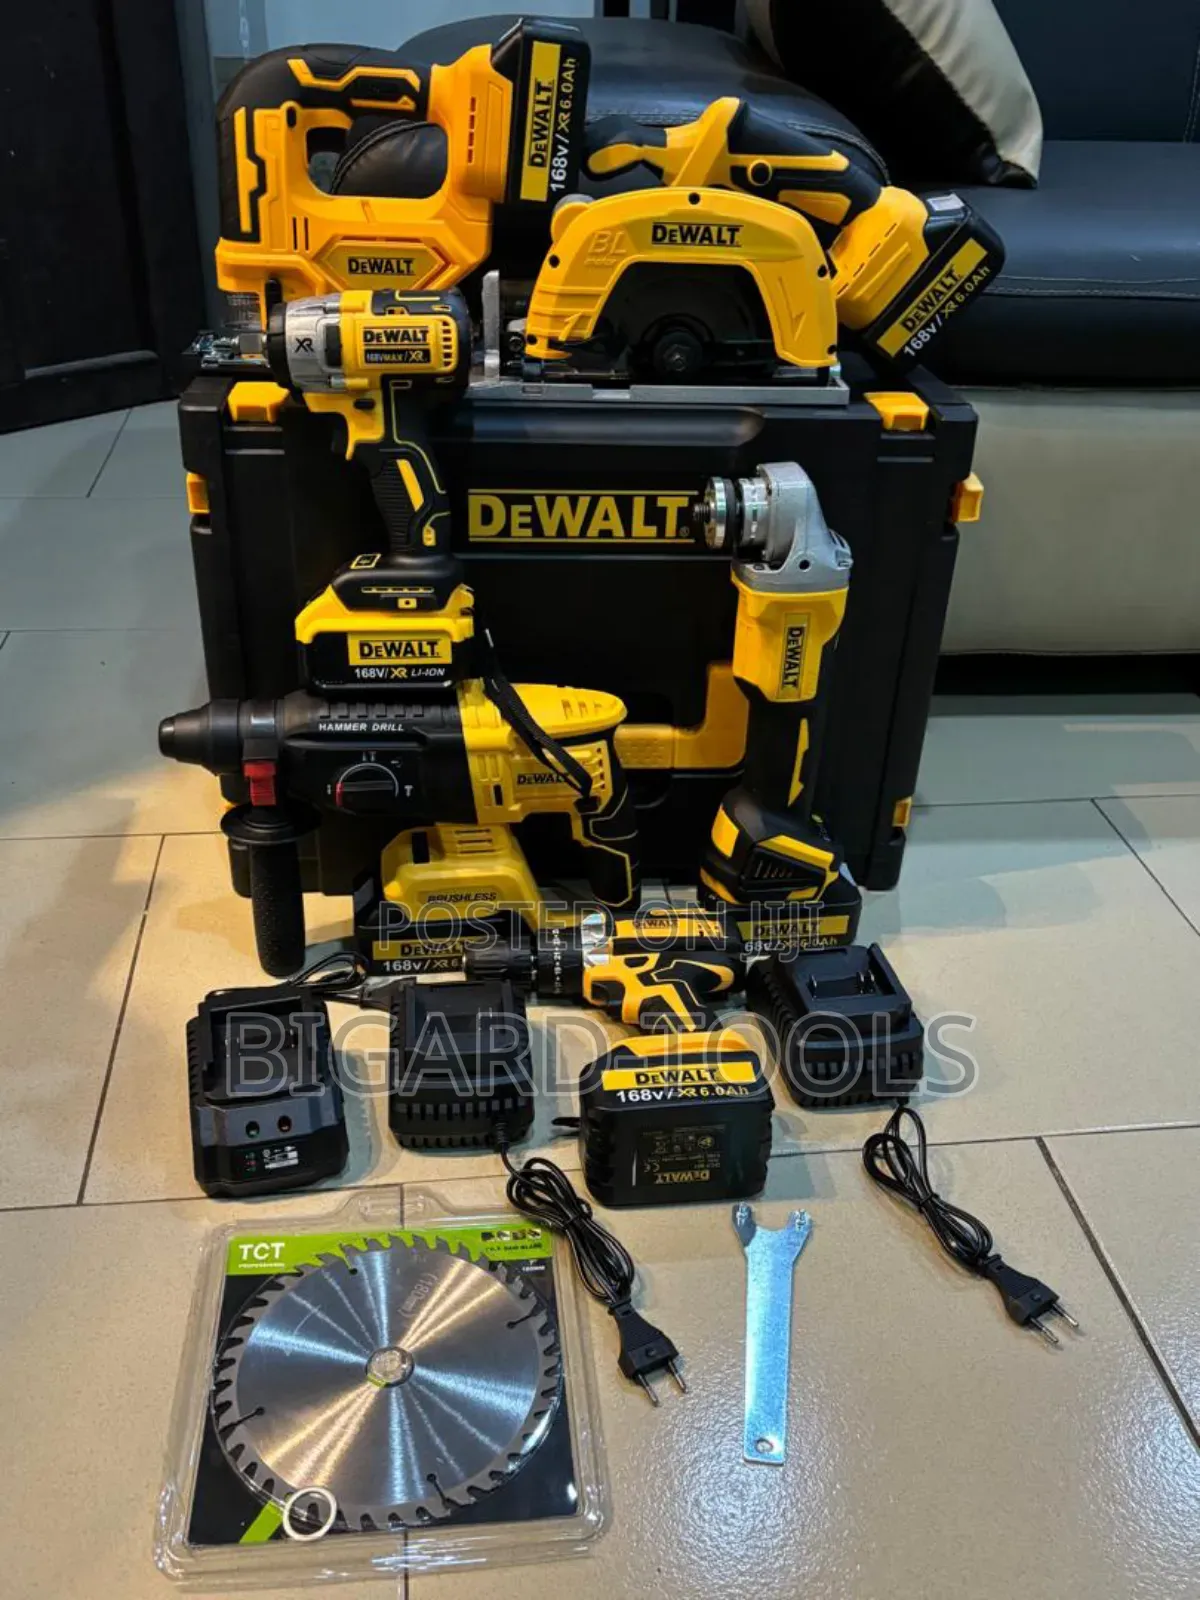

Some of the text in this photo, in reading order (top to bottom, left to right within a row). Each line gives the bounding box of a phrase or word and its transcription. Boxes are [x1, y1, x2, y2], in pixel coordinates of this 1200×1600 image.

[560, 58, 576, 111] 6.0Ah
[530, 81, 553, 167] DEWALT
[588, 230, 627, 253] BL
[652, 224, 740, 245] DEWALT
[348, 258, 414, 274] DEWALT
[955, 265, 991, 302] 6.0Ah
[902, 266, 960, 332] DEWALT
[364, 329, 428, 343] DEWALT
[295, 338, 314, 353] XR
[468, 494, 689, 537] DEWALT
[360, 641, 438, 657] DEWALT
[783, 627, 803, 687] DEWALT
[319, 722, 404, 731] HAMMER DRILL
[517, 773, 566, 785] DEWAL
[428, 891, 497, 903] BRUSHLESS
[401, 942, 464, 957] DEWAL
[635, 1069, 717, 1085] DEWALT
[700, 1085, 749, 1097] 6.0Ah
[238, 1242, 285, 1261] TCT
